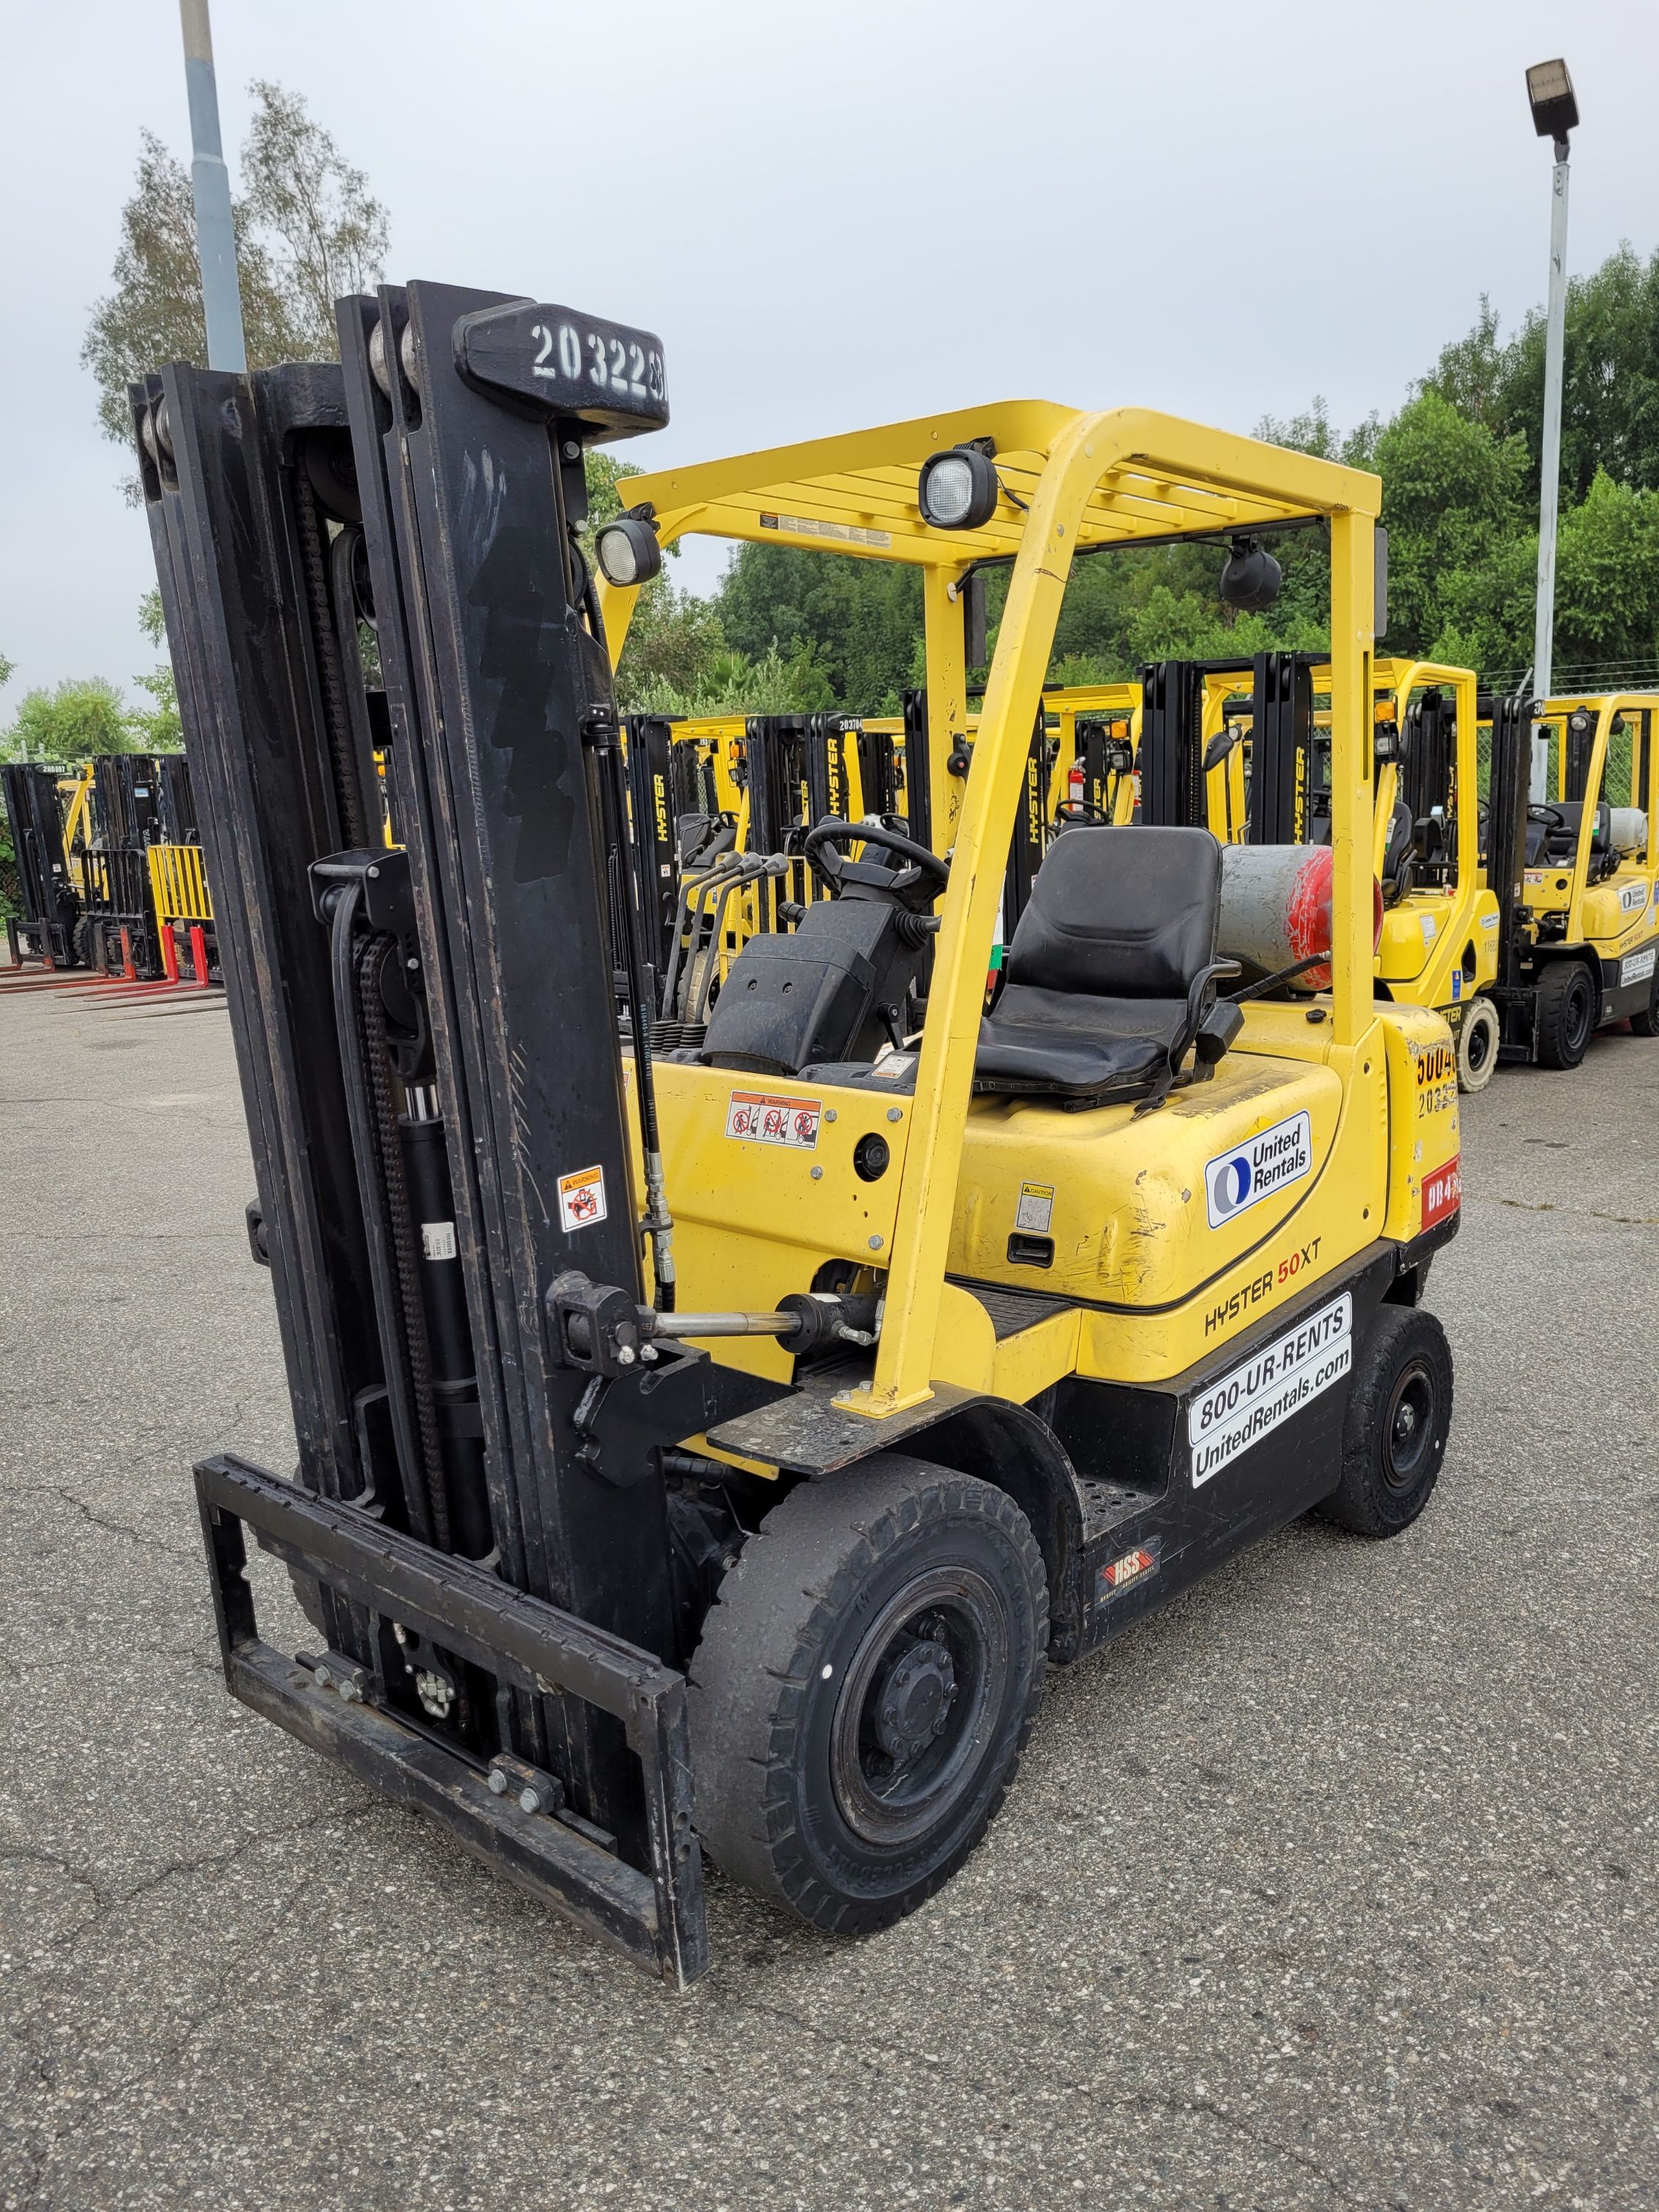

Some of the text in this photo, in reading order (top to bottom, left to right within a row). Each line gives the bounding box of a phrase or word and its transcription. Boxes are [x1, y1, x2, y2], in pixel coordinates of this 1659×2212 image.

[654, 774, 668, 842] HYSTER
[827, 738, 840, 815] HYSTER
[1028, 757, 1039, 844] HYSTER
[1295, 747, 1305, 845] HYSTER
[768, 1099, 791, 1107] WARNING
[572, 1172, 599, 1186] WARNING
[1253, 1122, 1301, 1168] United
[1253, 1148, 1306, 1194] Rentals
[1030, 1188, 1053, 1196] CAUTION
[1205, 1236, 1322, 1337] HYSTER 50XT
[1200, 1305, 1344, 1430] 800-UR-RENTS
[1195, 1348, 1350, 1478] UnitedRentals.com
[1115, 1551, 1140, 1586] HSS
